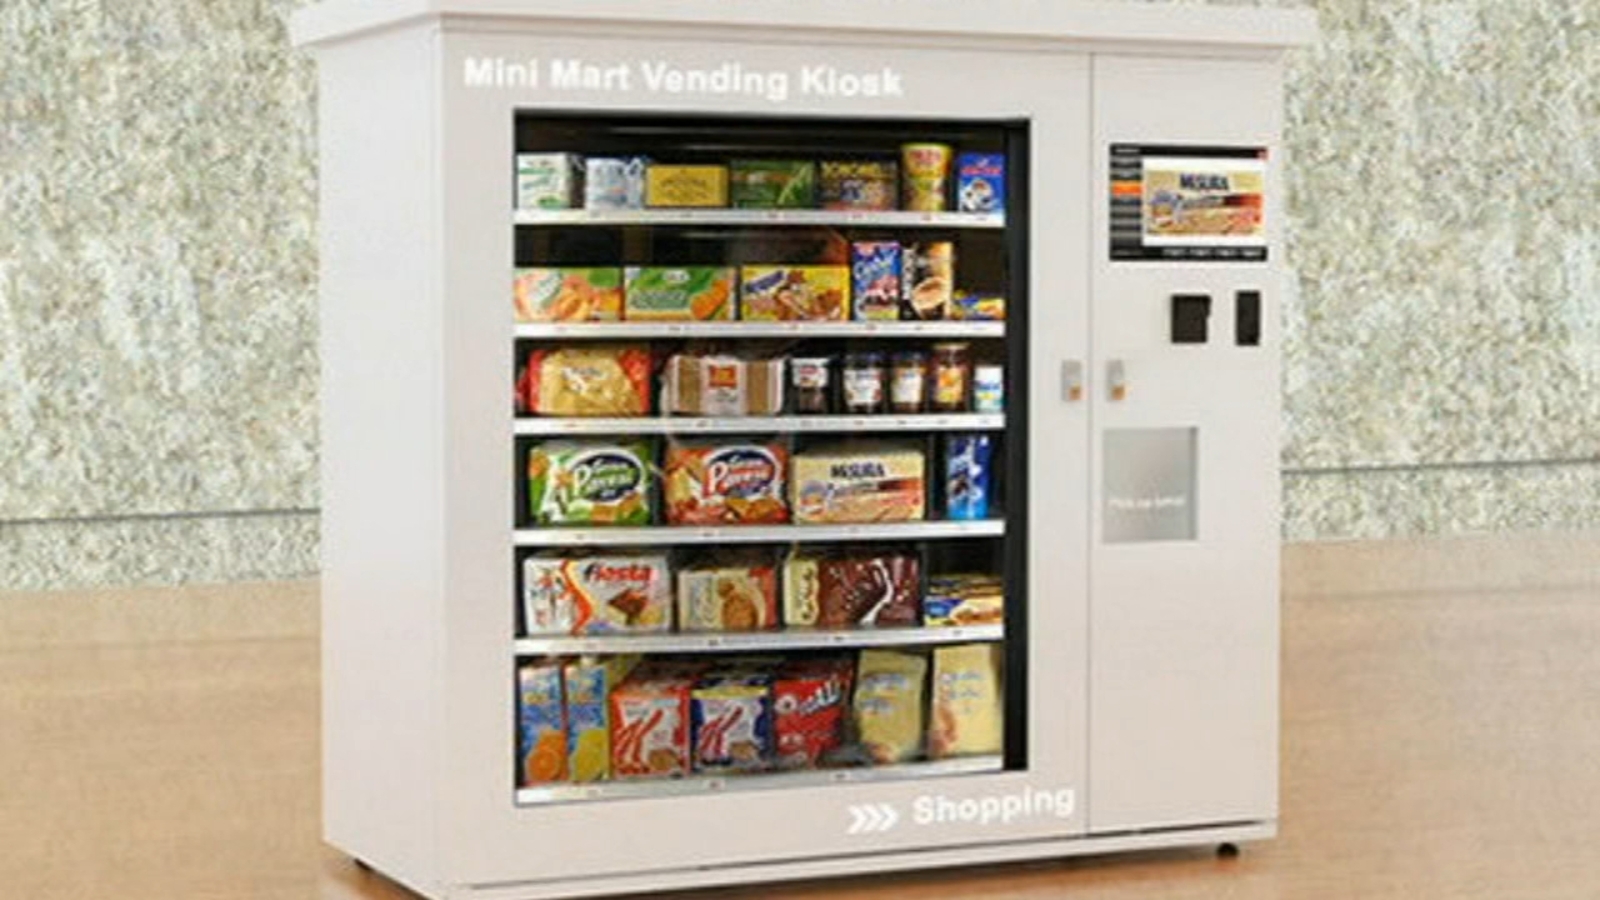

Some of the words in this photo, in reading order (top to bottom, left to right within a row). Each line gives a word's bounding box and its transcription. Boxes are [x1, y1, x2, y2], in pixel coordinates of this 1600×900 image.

[464, 57, 538, 89] Mini
[550, 58, 630, 91] Mart
[641, 61, 789, 101] Vending
[801, 66, 904, 96] Kiosk
[913, 786, 1075, 825] Shopping
